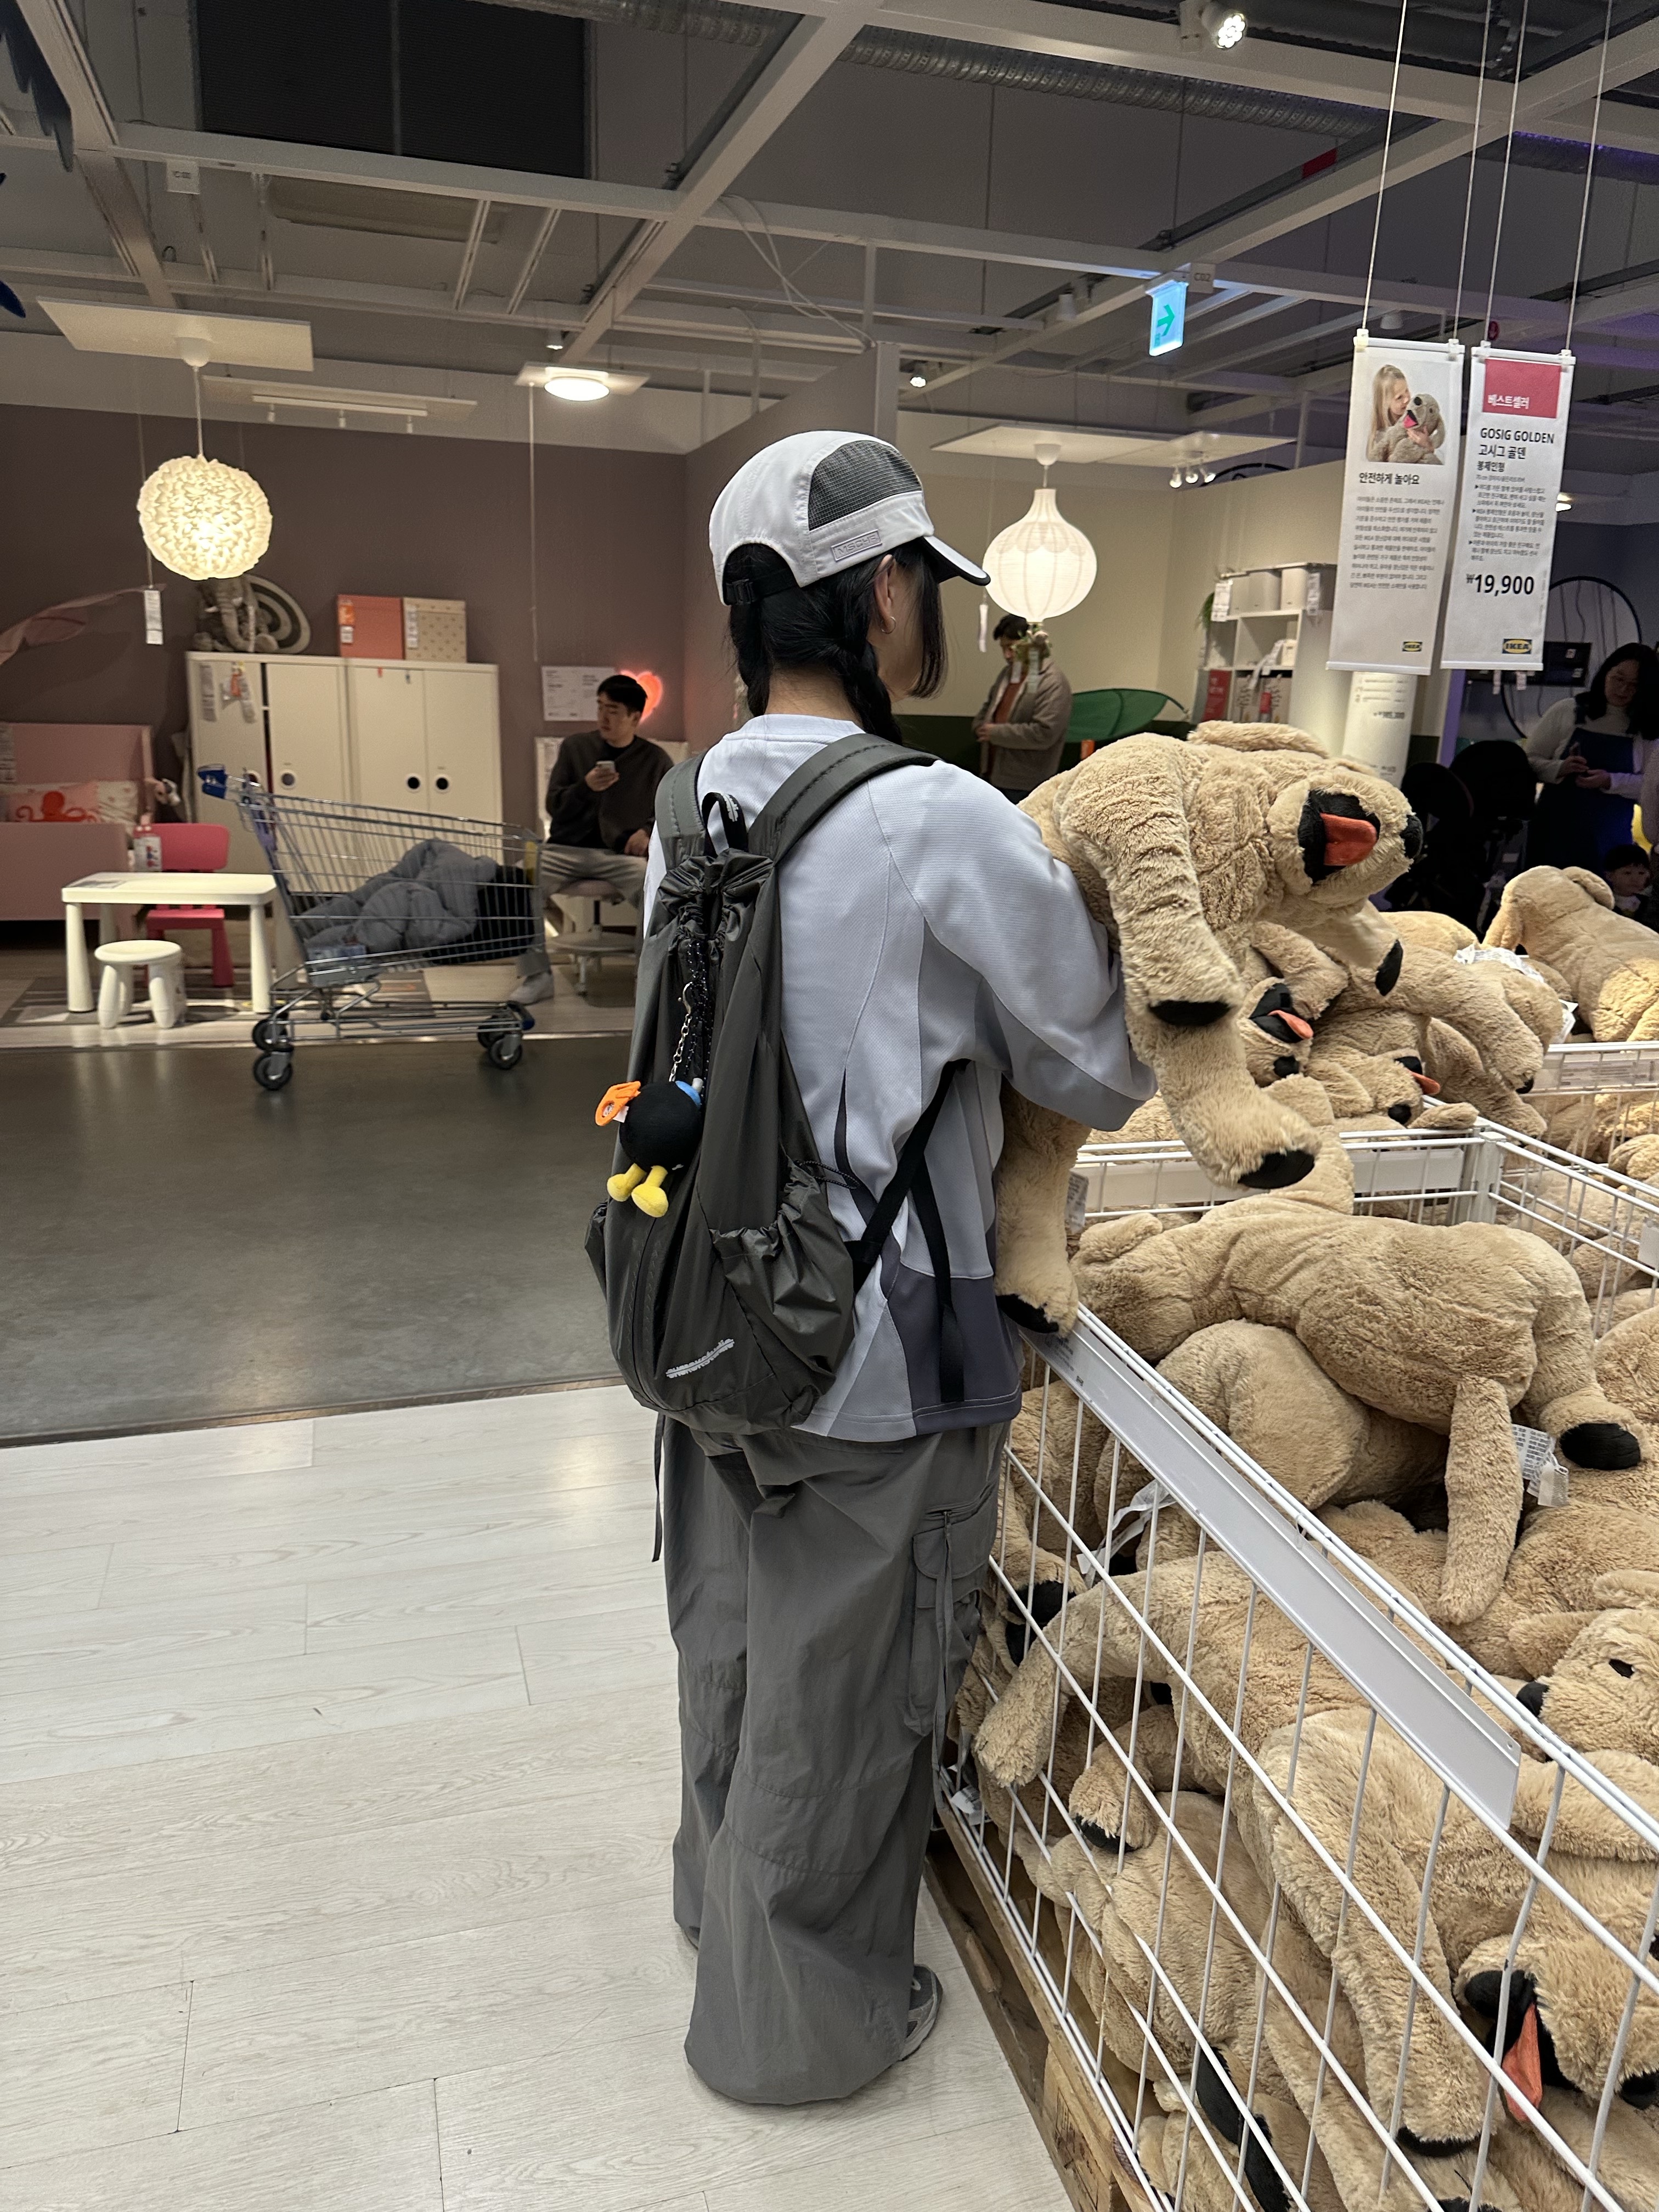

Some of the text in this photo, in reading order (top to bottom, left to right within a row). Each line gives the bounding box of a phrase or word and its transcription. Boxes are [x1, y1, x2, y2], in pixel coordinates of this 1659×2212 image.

[1487, 394, 1530, 409] 베스트셀러
[1480, 427, 1555, 444] GOSIG GOLDEN
[1479, 444, 1505, 458] 고시그
[1477, 460, 1505, 472] 봉제인형
[1359, 472, 1420, 486] 안전하게 놀아요
[1466, 574, 1534, 597] ₩19,900
